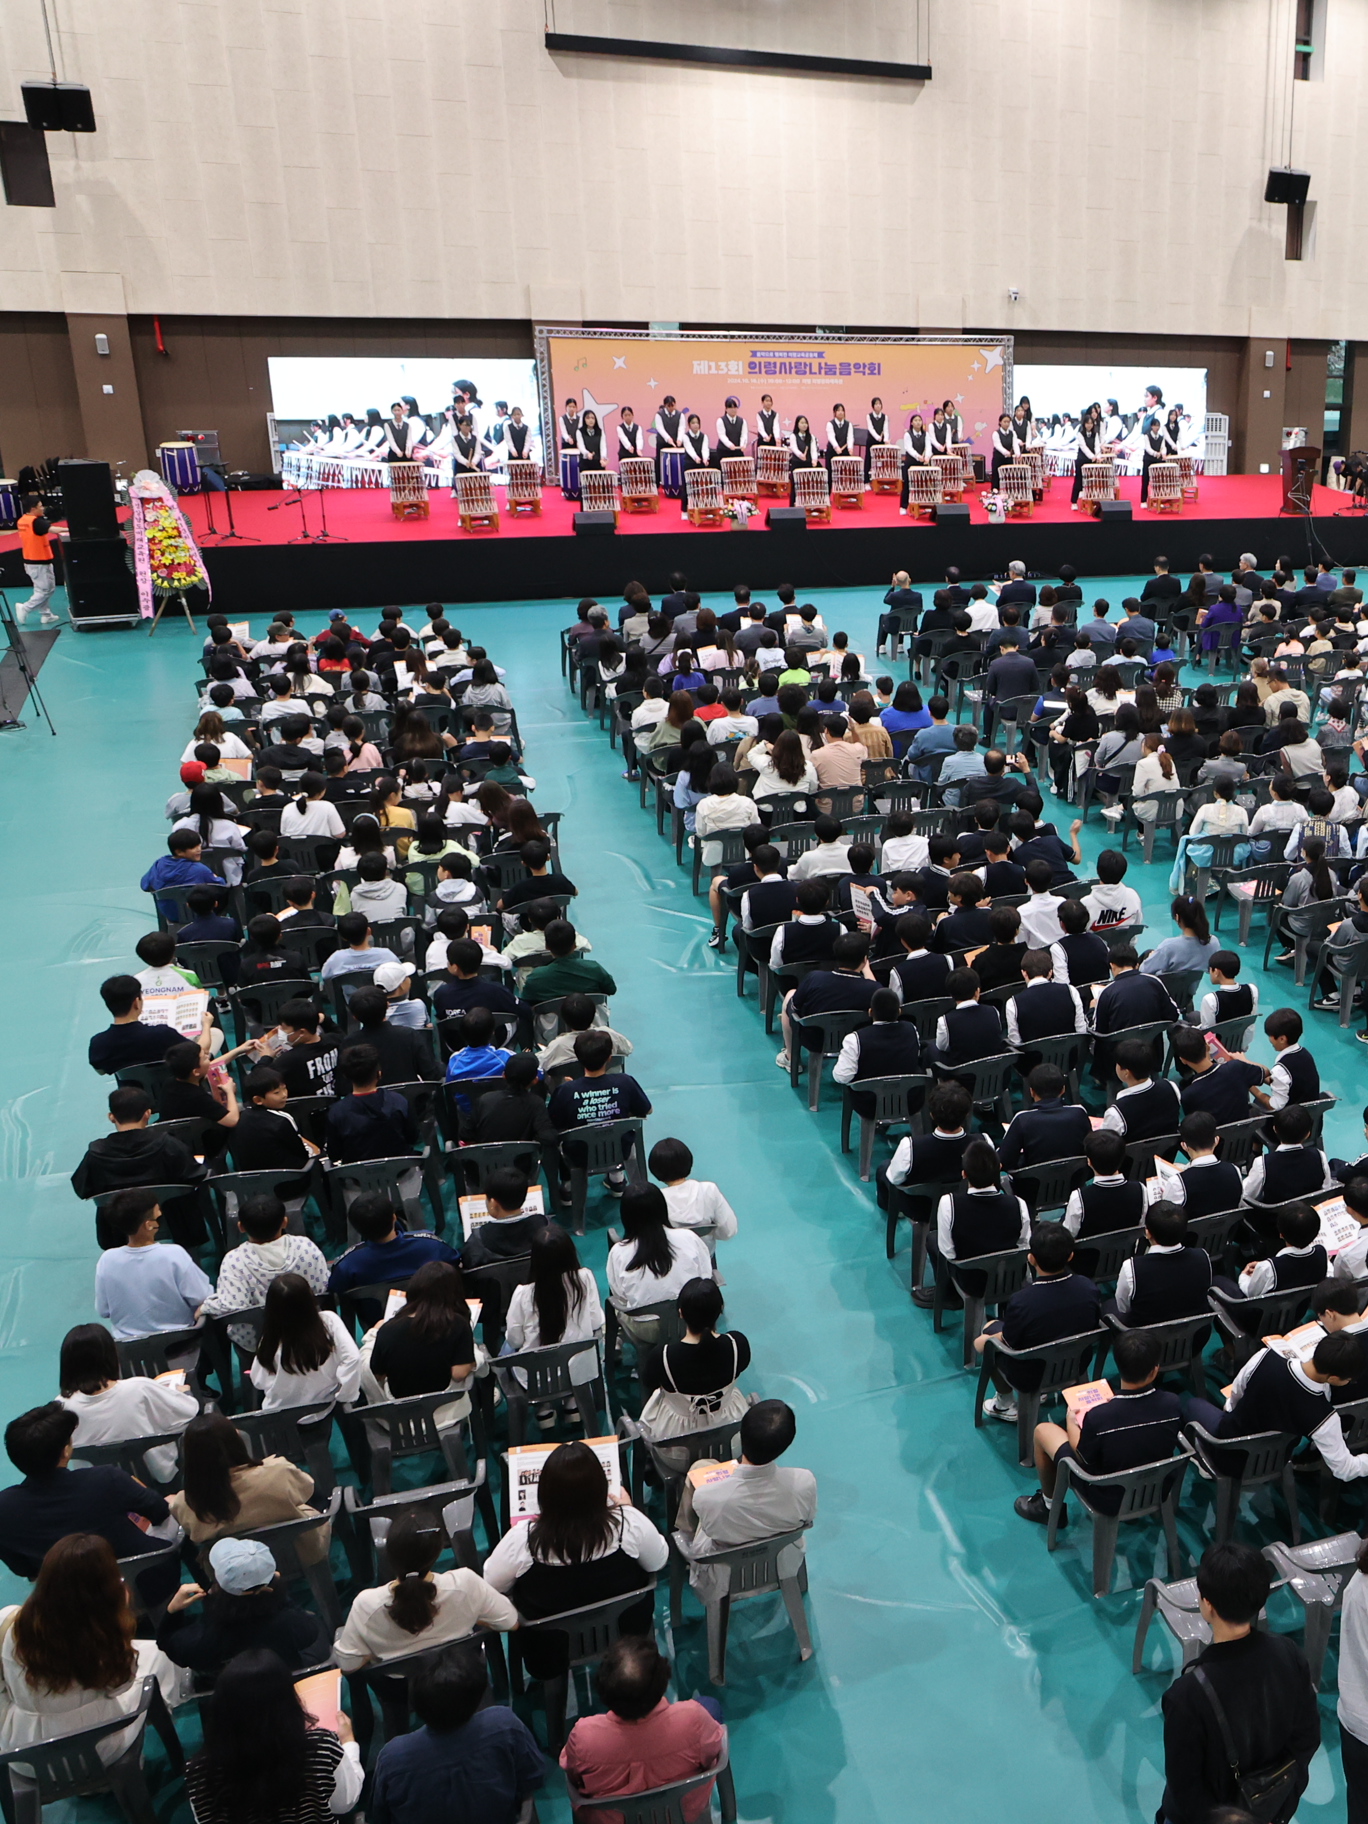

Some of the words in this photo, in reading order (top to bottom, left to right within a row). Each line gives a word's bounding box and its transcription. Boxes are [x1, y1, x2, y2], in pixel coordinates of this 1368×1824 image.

[692, 360, 744, 375] 제13회
[747, 361, 882, 376] 의령사랑나눔음악회
[1097, 907, 1127, 924] NIKE
[306, 1047, 338, 1080] FROM
[573, 1091, 580, 1100] A
[580, 1088, 611, 1099] winner
[612, 1086, 619, 1095] is
[577, 1104, 597, 1113] who
[598, 1101, 618, 1110] tried
[589, 1096, 611, 1105] loser
[576, 1111, 597, 1120] once
[597, 1108, 621, 1118] more
